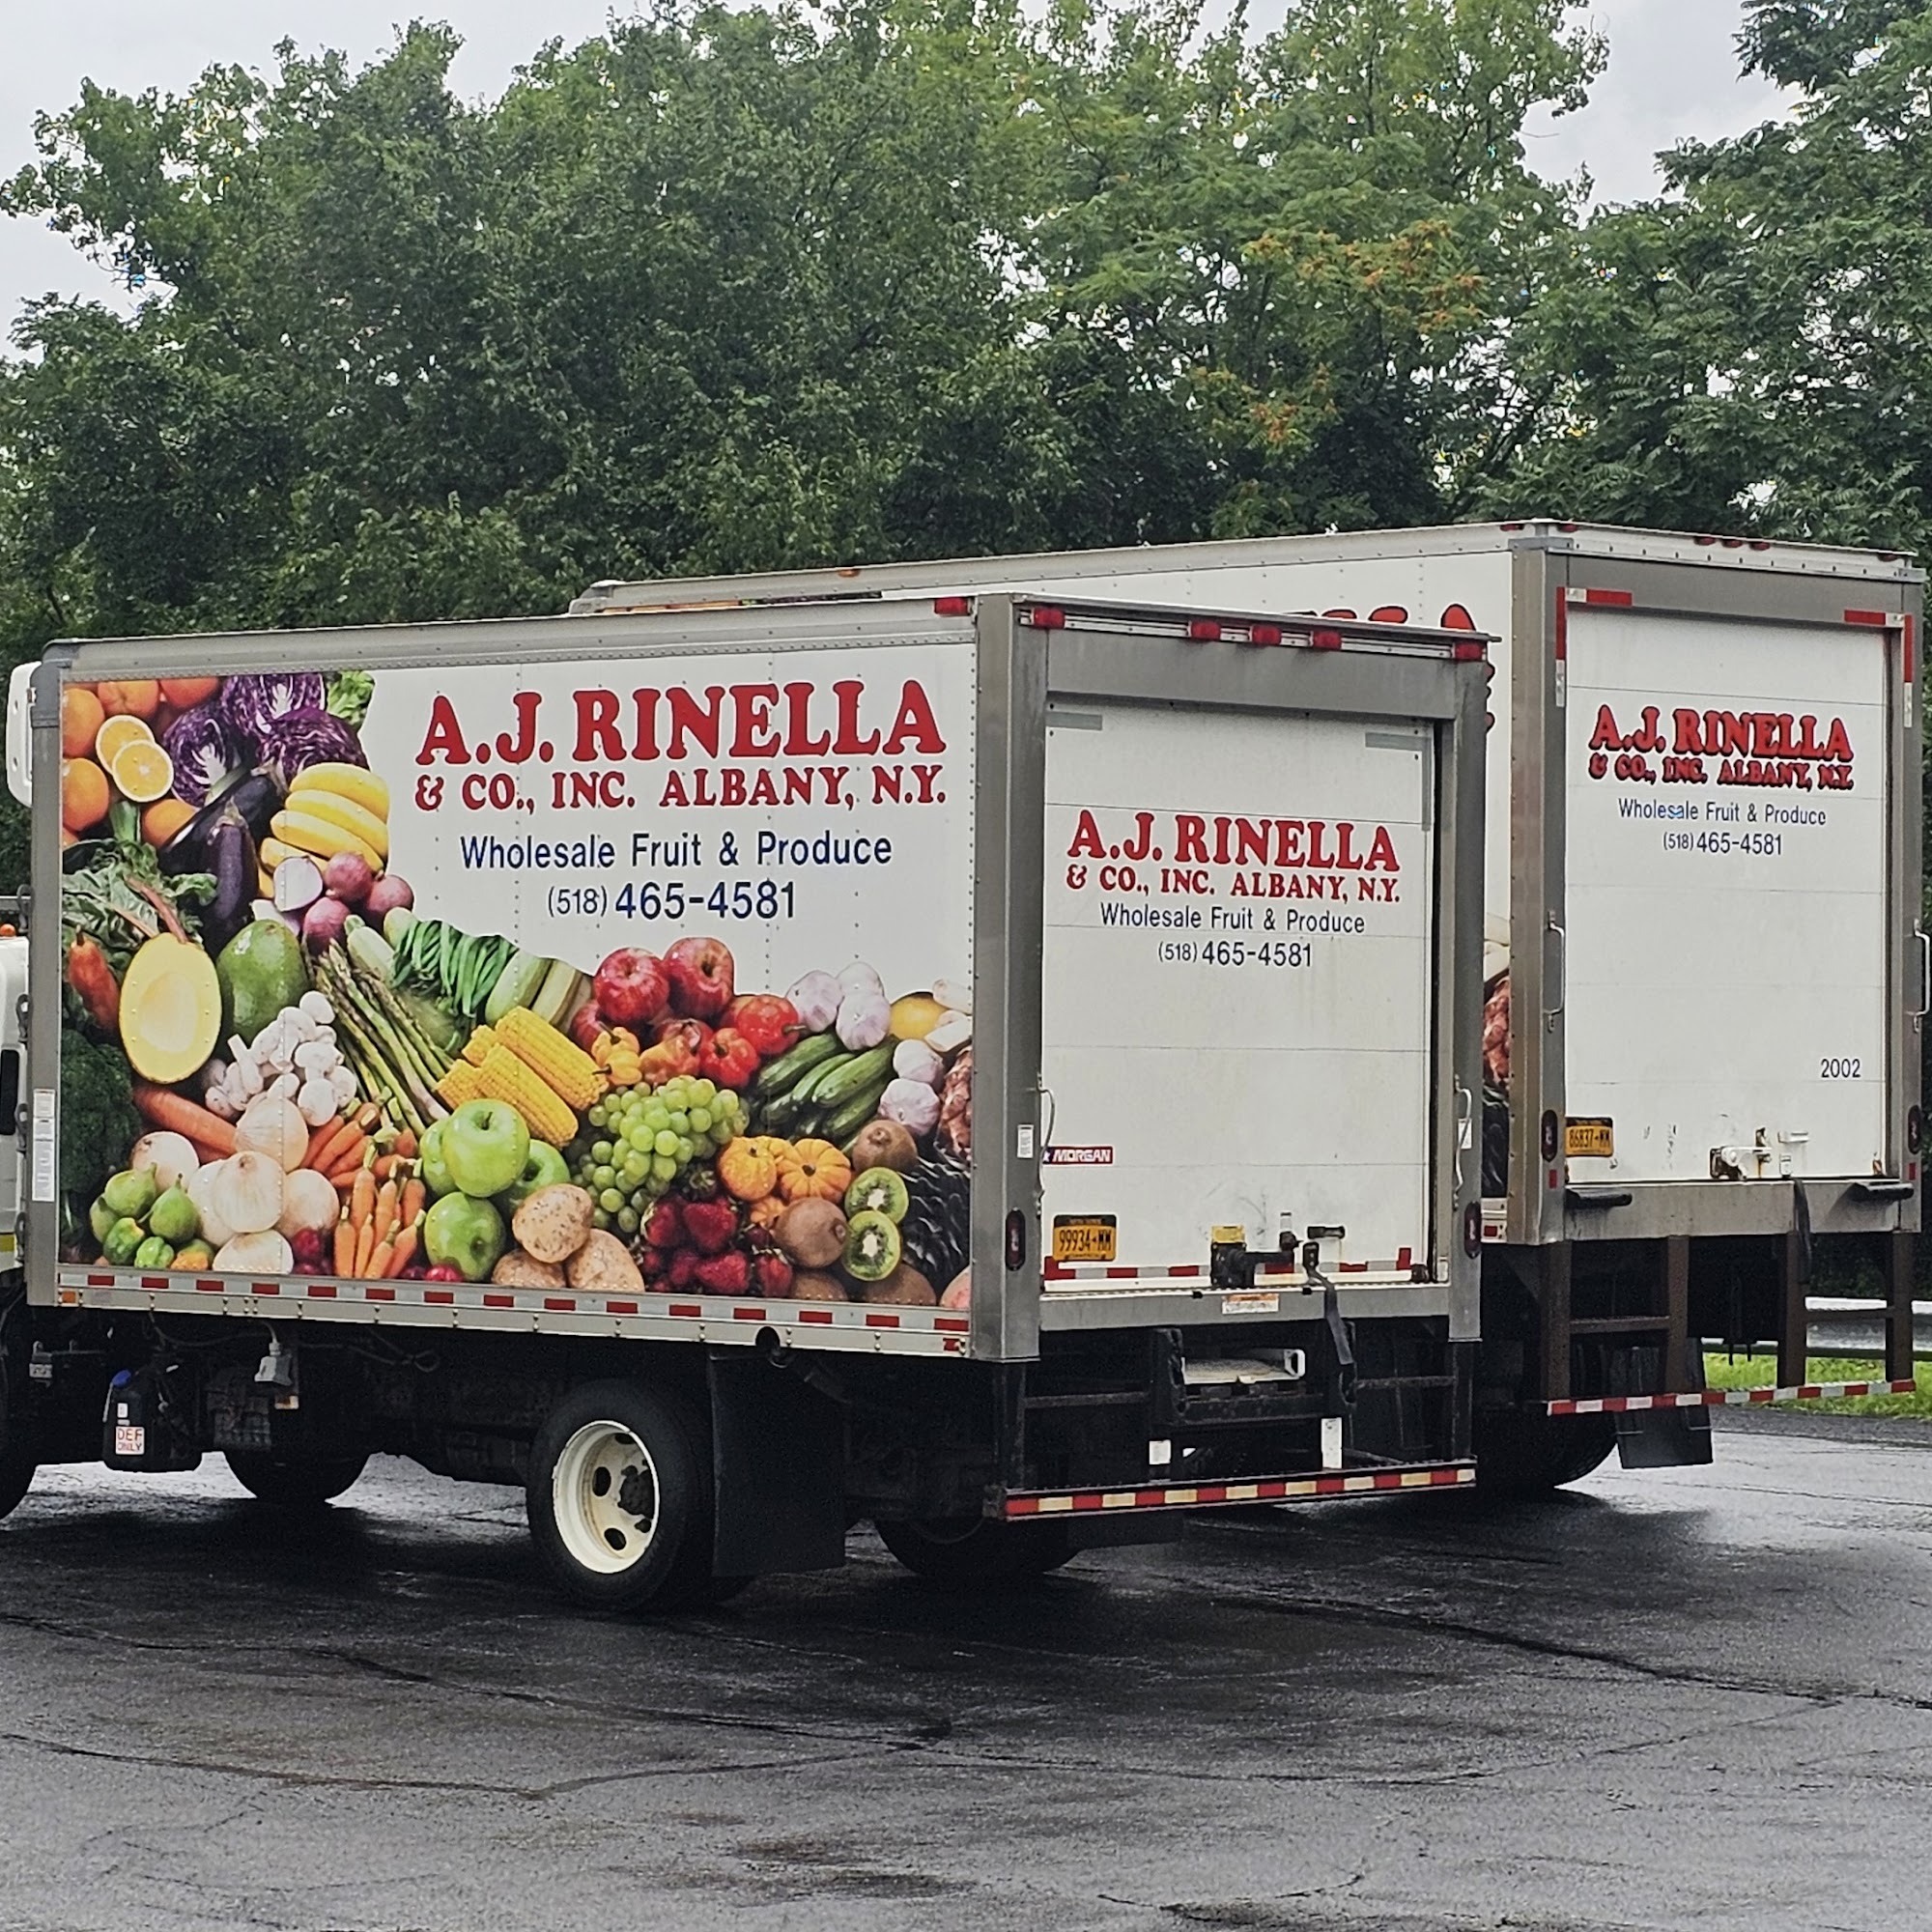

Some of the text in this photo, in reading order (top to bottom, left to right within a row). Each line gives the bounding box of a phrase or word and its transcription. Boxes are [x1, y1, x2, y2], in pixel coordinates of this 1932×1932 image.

[415, 680, 947, 764] A.J. RINELLA
[1589, 704, 1854, 762] A.J. RINELLA
[414, 764, 947, 814] & CO., INC. ALBANY, N.Y.
[1589, 753, 1854, 792] & CO., INC. ALBANY, N.Y.
[1618, 798, 1827, 826] Wholesale Fruit & Produce
[461, 830, 893, 869] Wholesale Fruit & Produce
[1067, 810, 1401, 871] A.J. RINELLA
[1662, 832, 1782, 856] (518) 465-4581
[547, 881, 797, 920] (518) 465-4581
[1066, 865, 1401, 903] & CO., INC. ALBANY, N.Y.
[1100, 902, 1366, 933] Wholesale Fruit & Produce
[1158, 941, 1312, 967] (518) 465-4581
[1821, 1059, 1861, 1078] 2002
[1052, 1149, 1111, 1162] MORGAN
[118, 1429, 142, 1440] DEF
